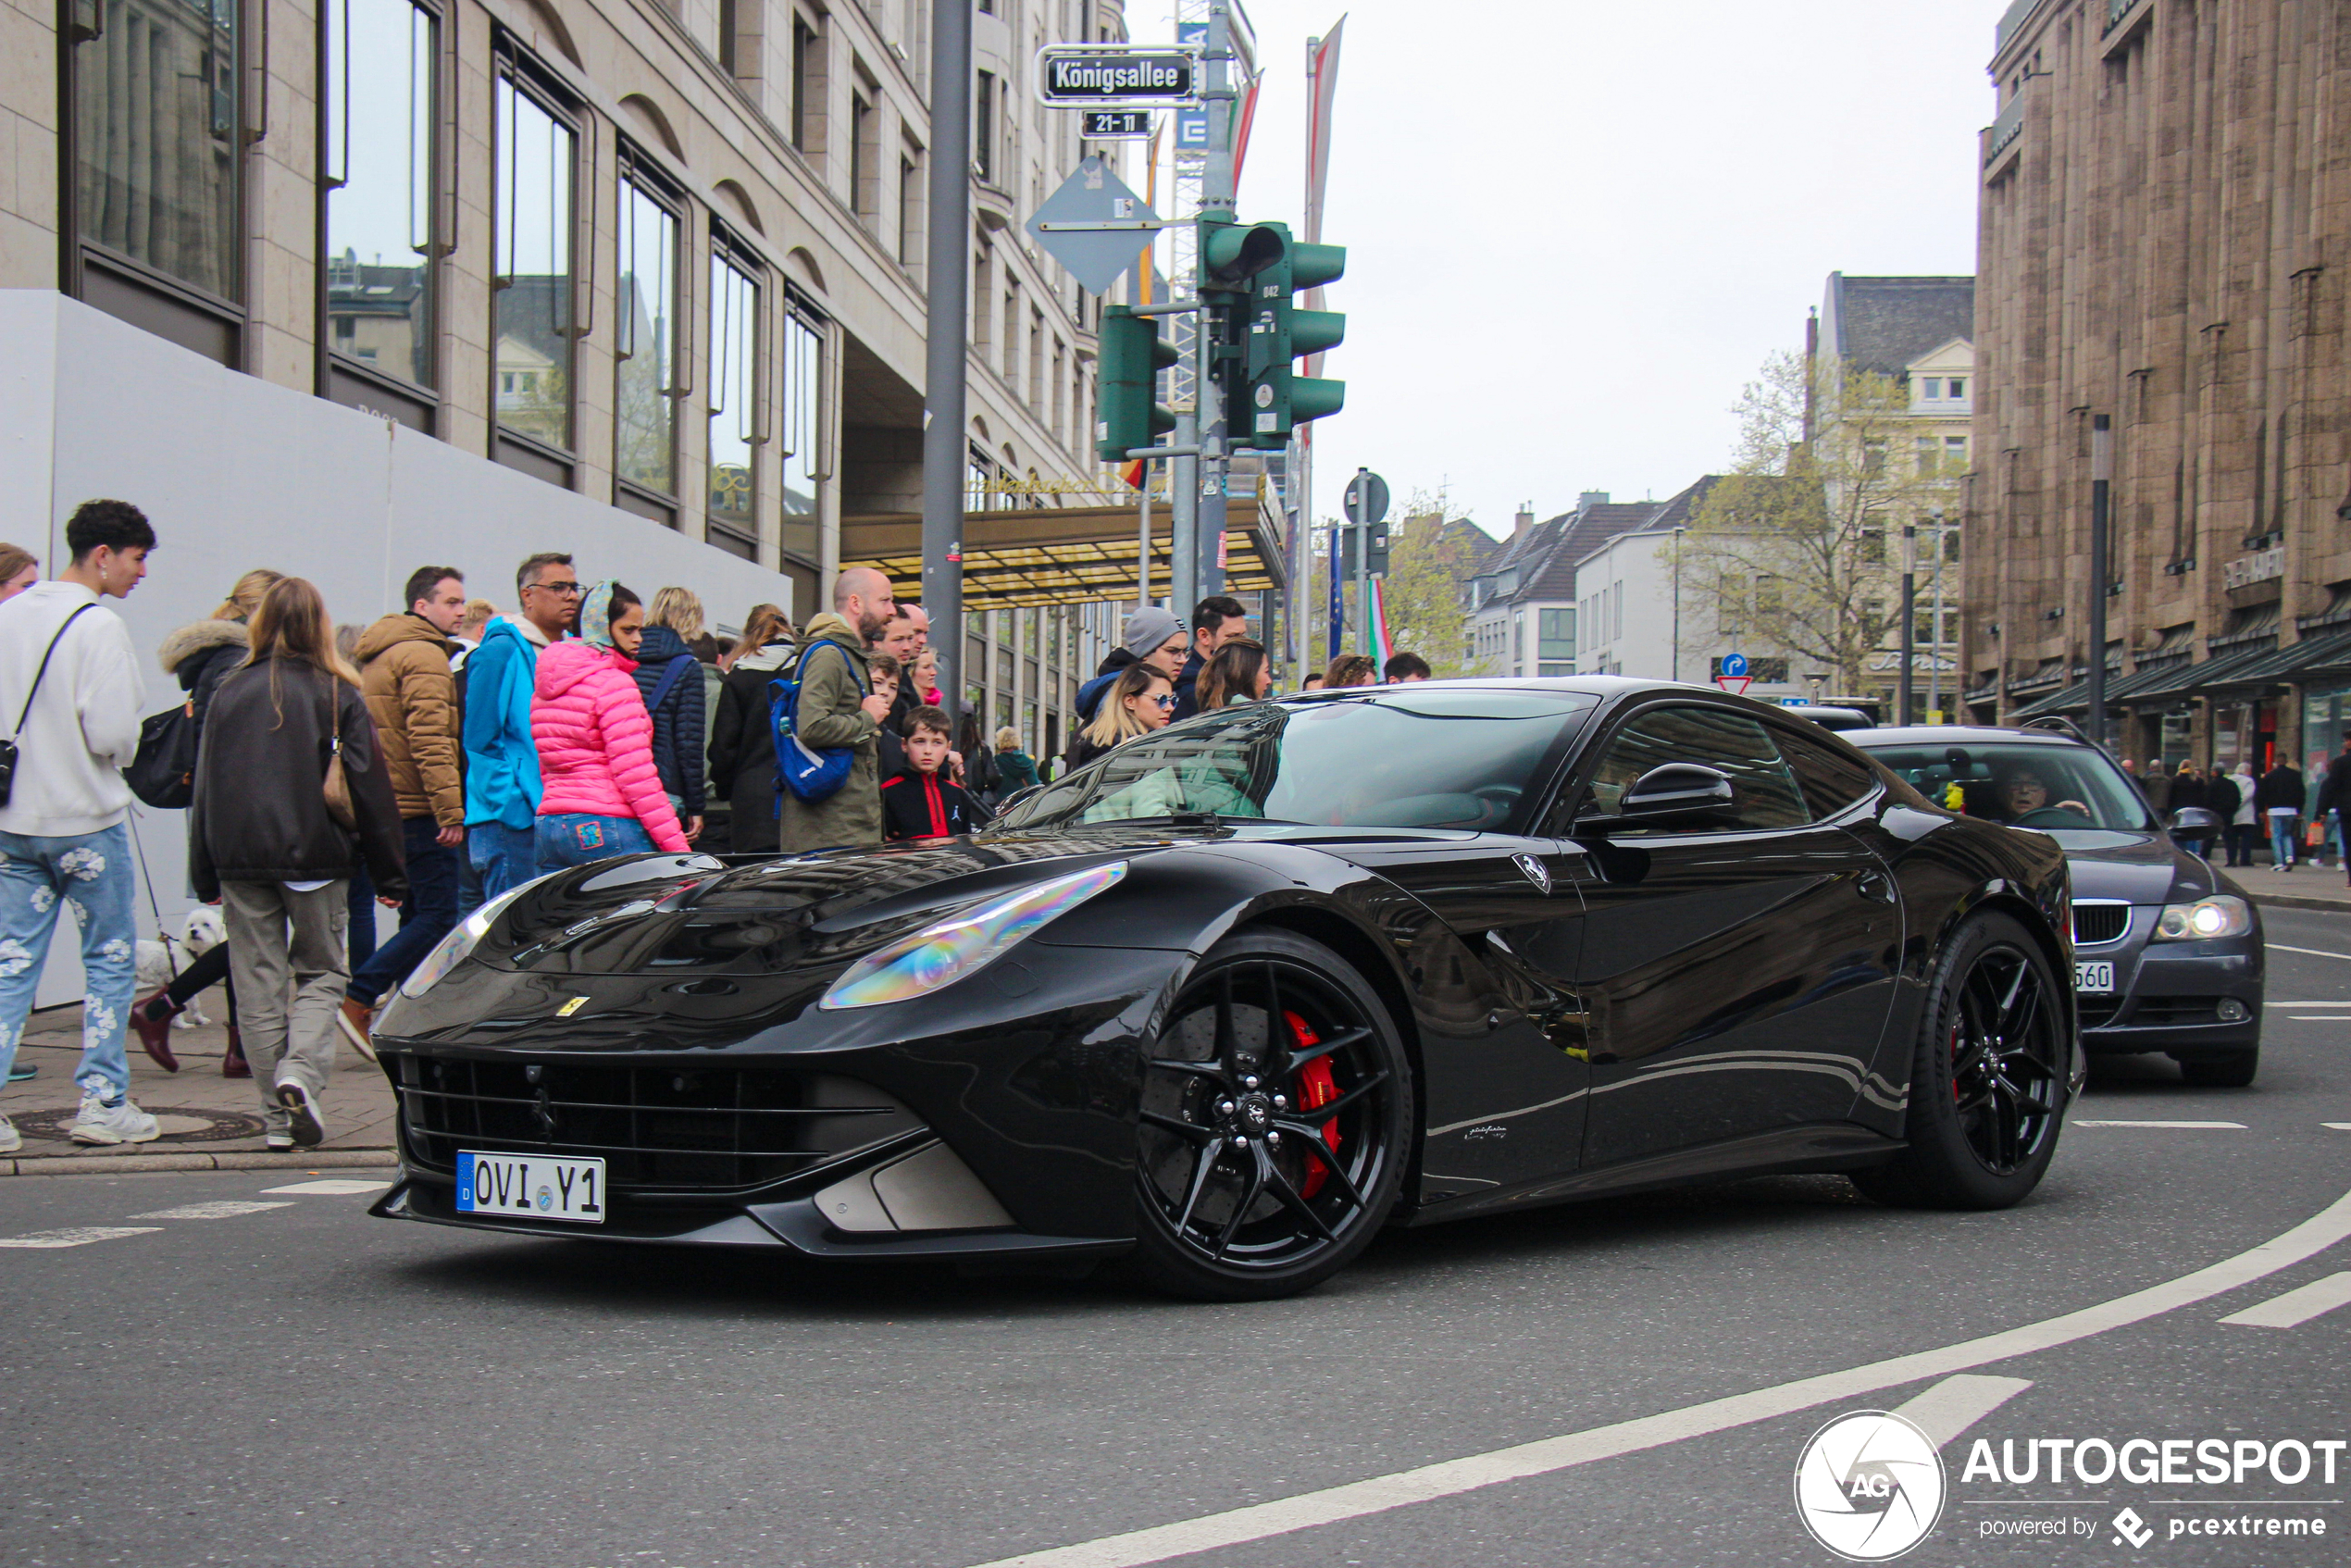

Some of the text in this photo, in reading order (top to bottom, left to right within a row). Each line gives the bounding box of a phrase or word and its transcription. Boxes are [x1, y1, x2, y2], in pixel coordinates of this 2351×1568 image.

[1056, 61, 1178, 93] Königsallee
[1263, 285, 1279, 298] 042
[462, 1160, 600, 1213] D OVI Y1
